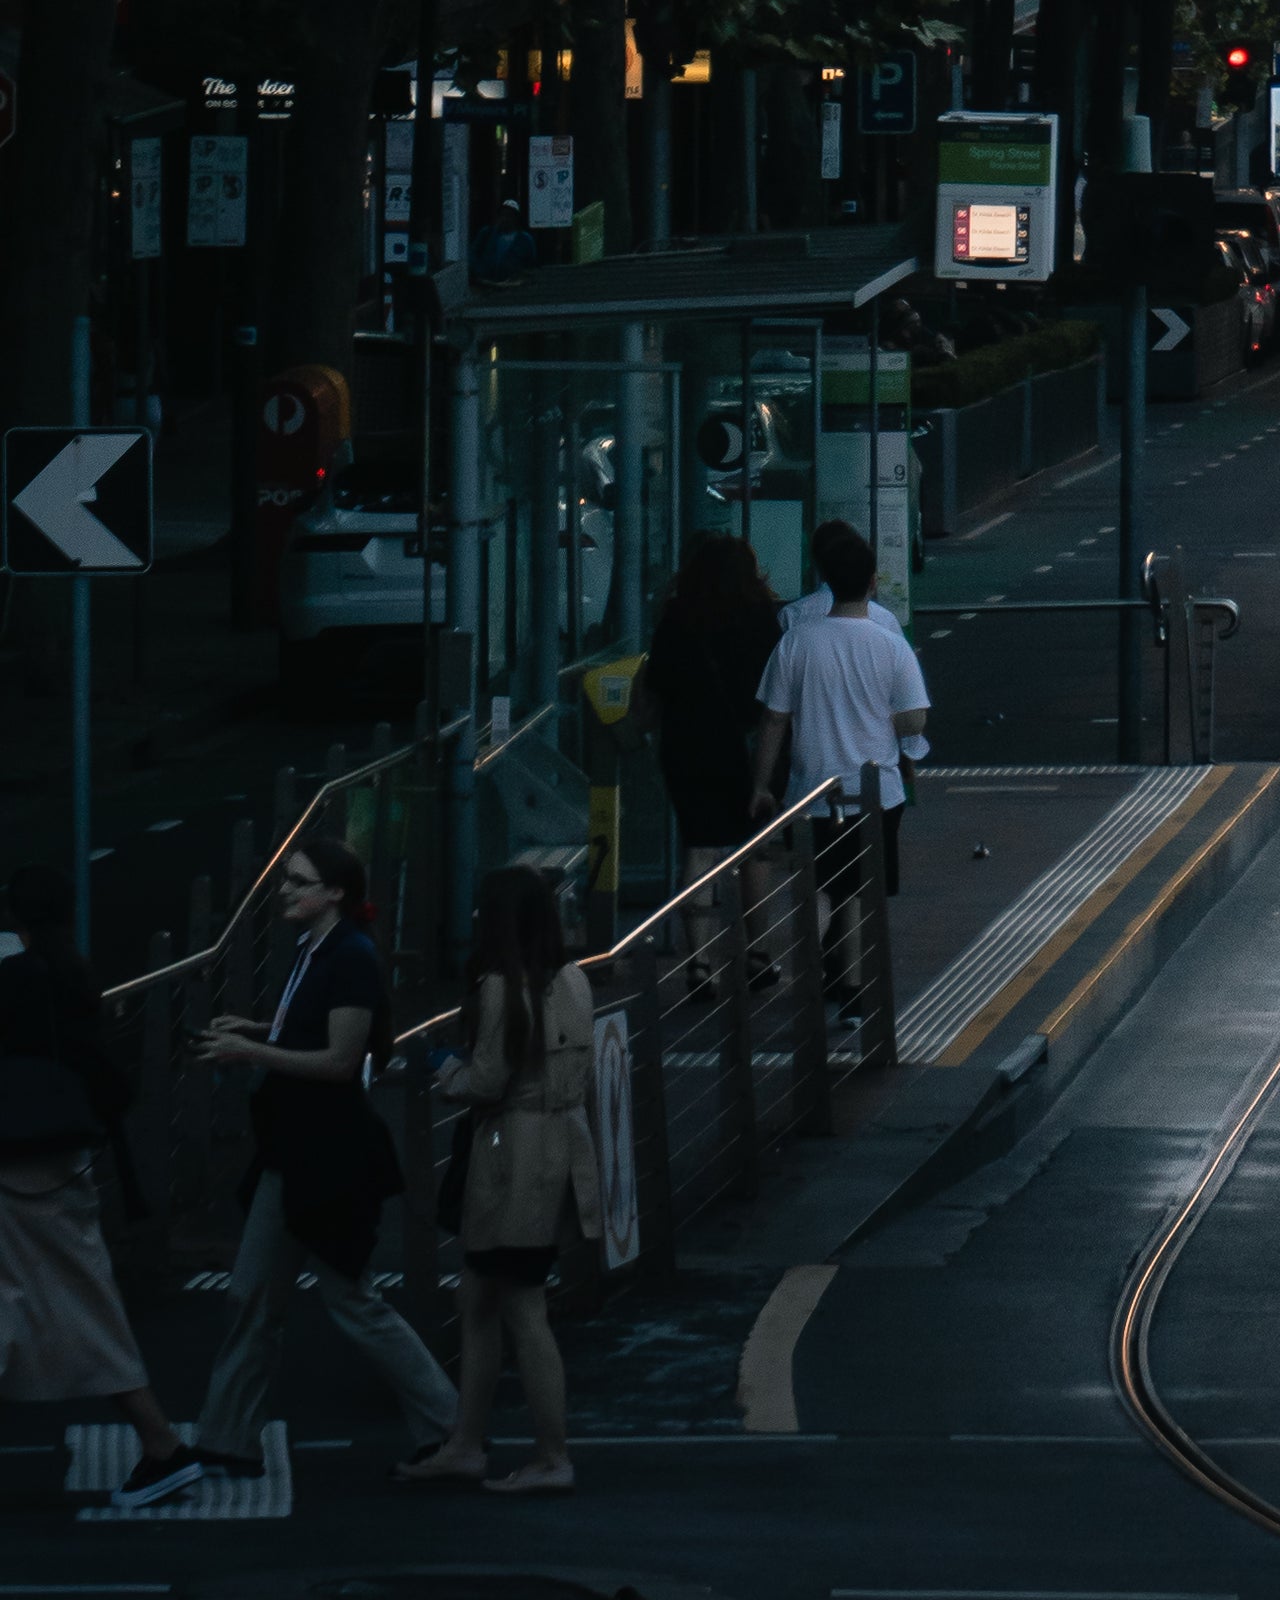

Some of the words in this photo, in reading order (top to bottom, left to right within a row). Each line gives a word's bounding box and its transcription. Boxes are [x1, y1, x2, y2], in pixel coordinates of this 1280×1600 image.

[202, 77, 237, 96] The
[870, 60, 903, 101] P
[969, 145, 1005, 161] Spring
[1007, 147, 1041, 160] Street
[893, 463, 906, 482] 9
